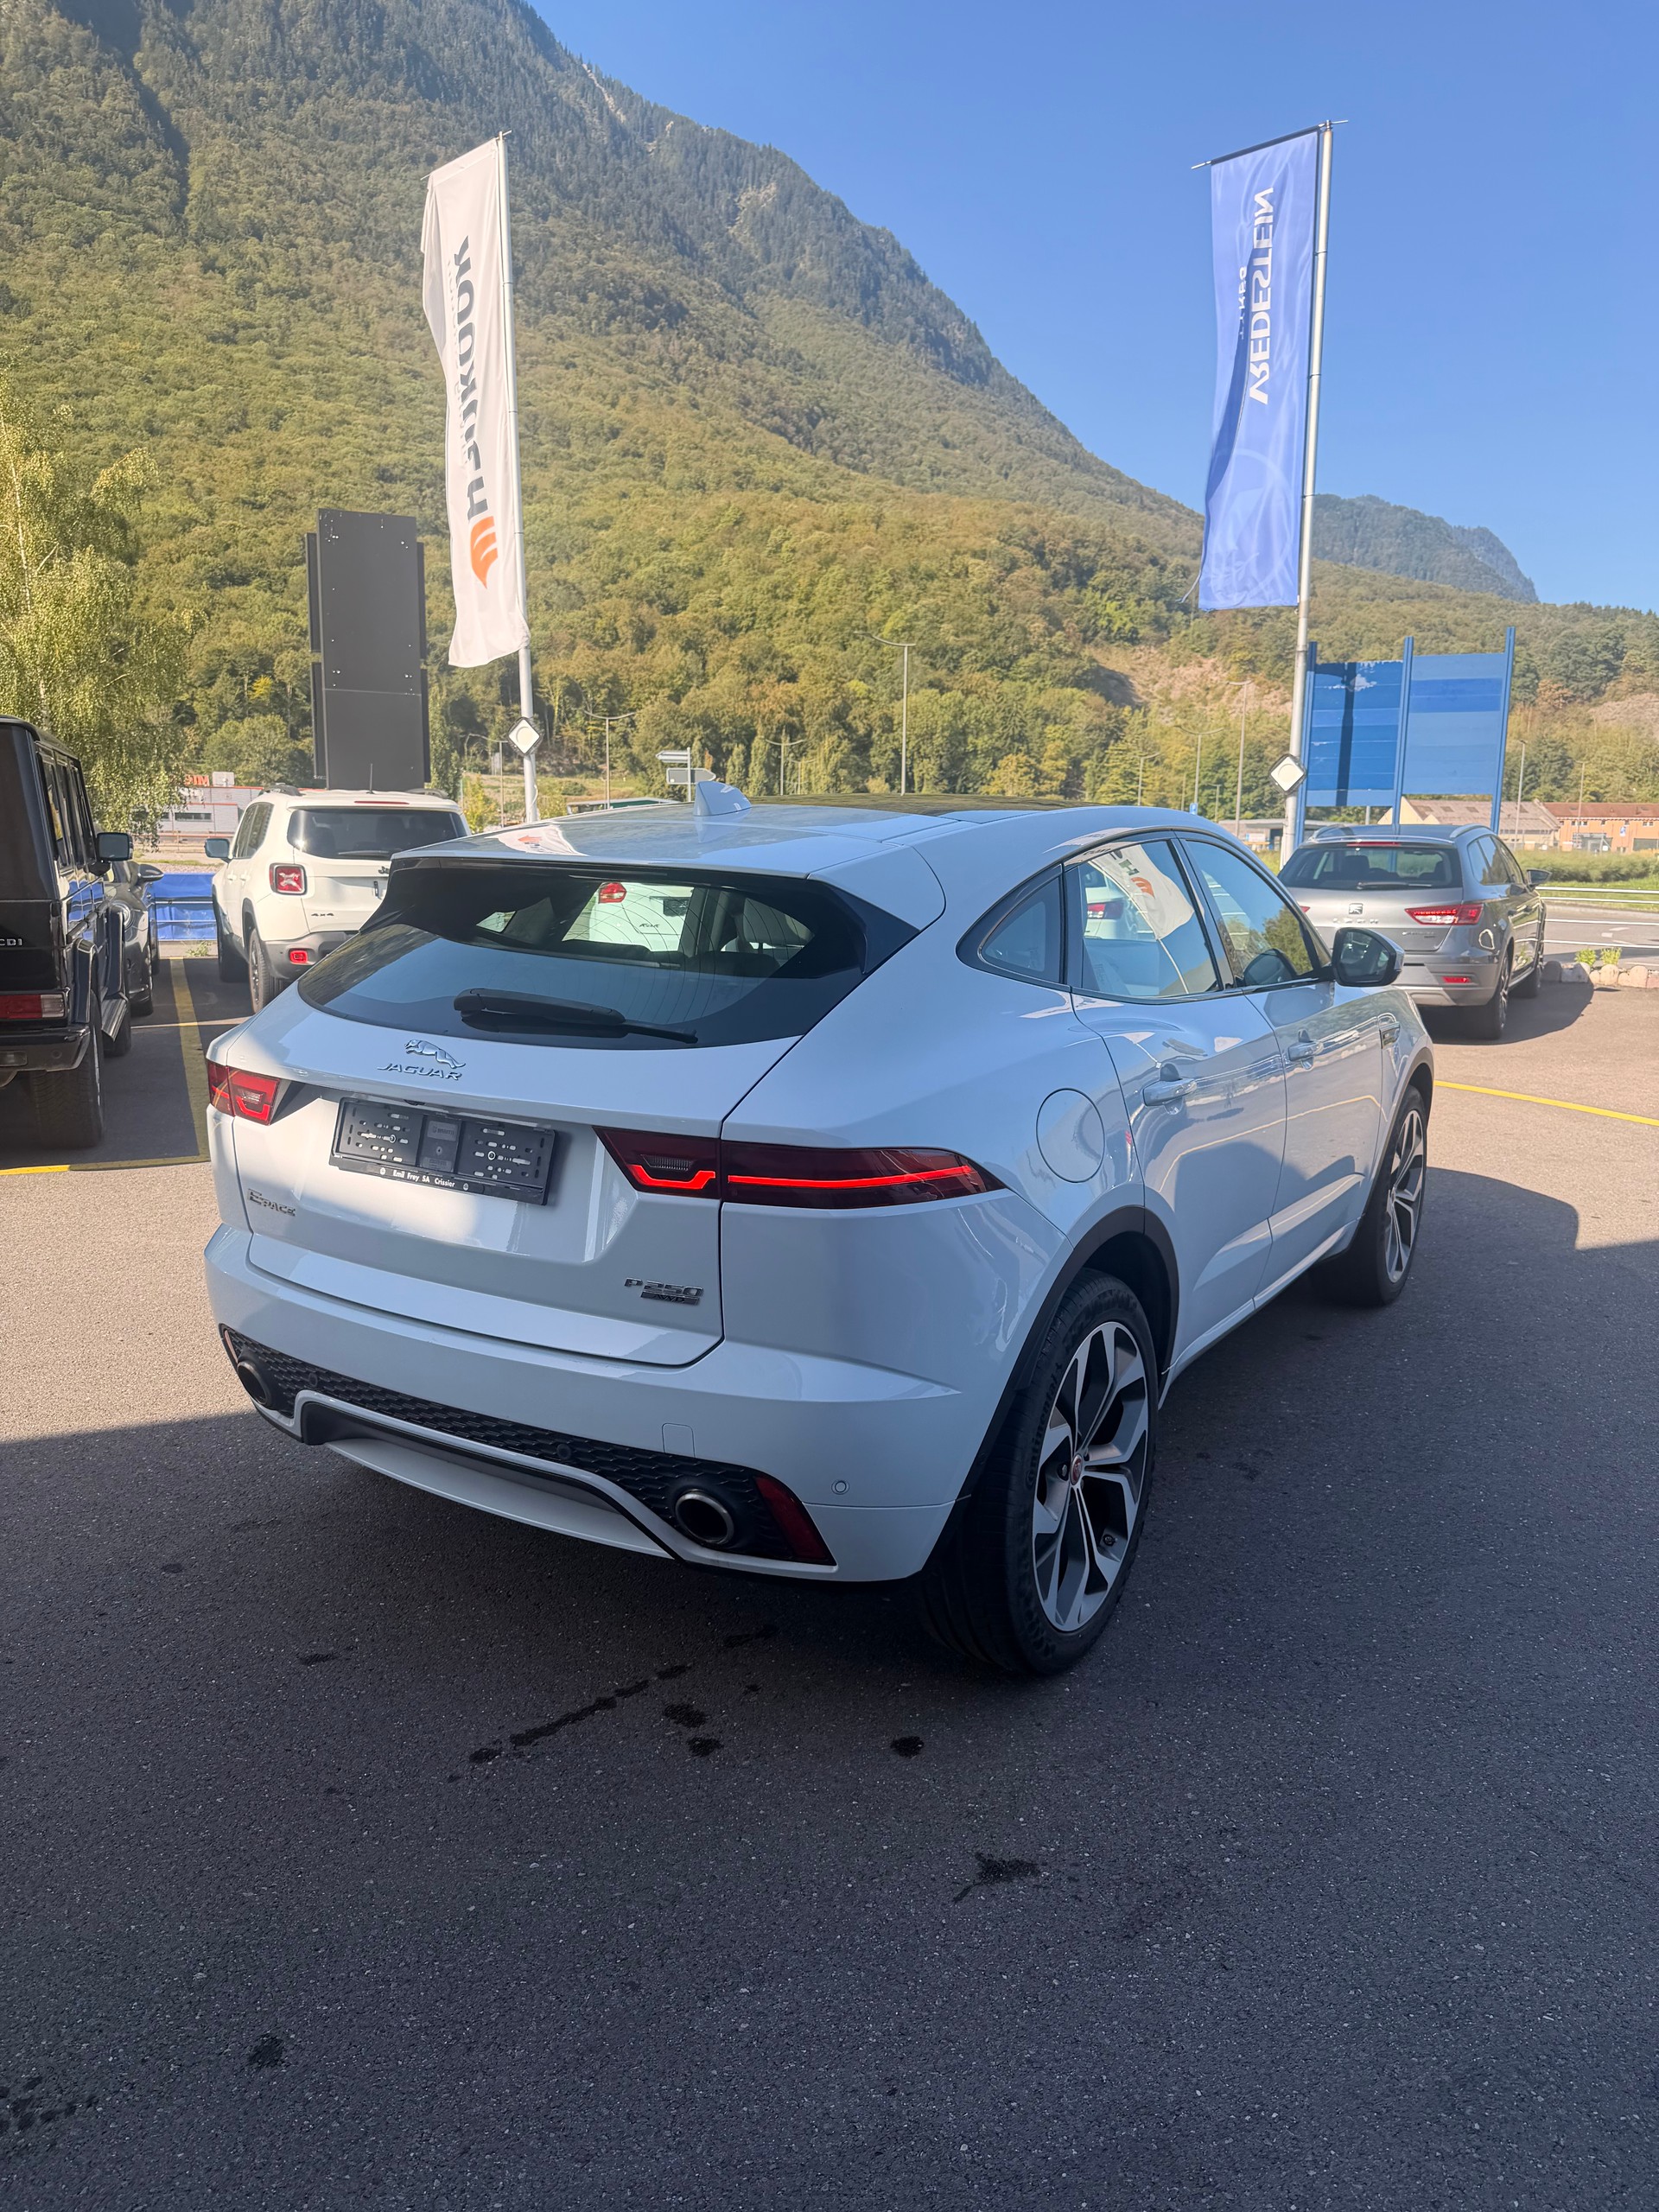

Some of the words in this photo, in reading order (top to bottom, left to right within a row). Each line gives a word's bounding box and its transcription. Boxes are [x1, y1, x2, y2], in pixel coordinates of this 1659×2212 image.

[377, 1063, 462, 1081] JAGUAR
[392, 1169, 405, 1179] Emil
[407, 1172, 420, 1182] Frey
[434, 1178, 455, 1188] Crissier
[624, 1277, 704, 1297] P250
